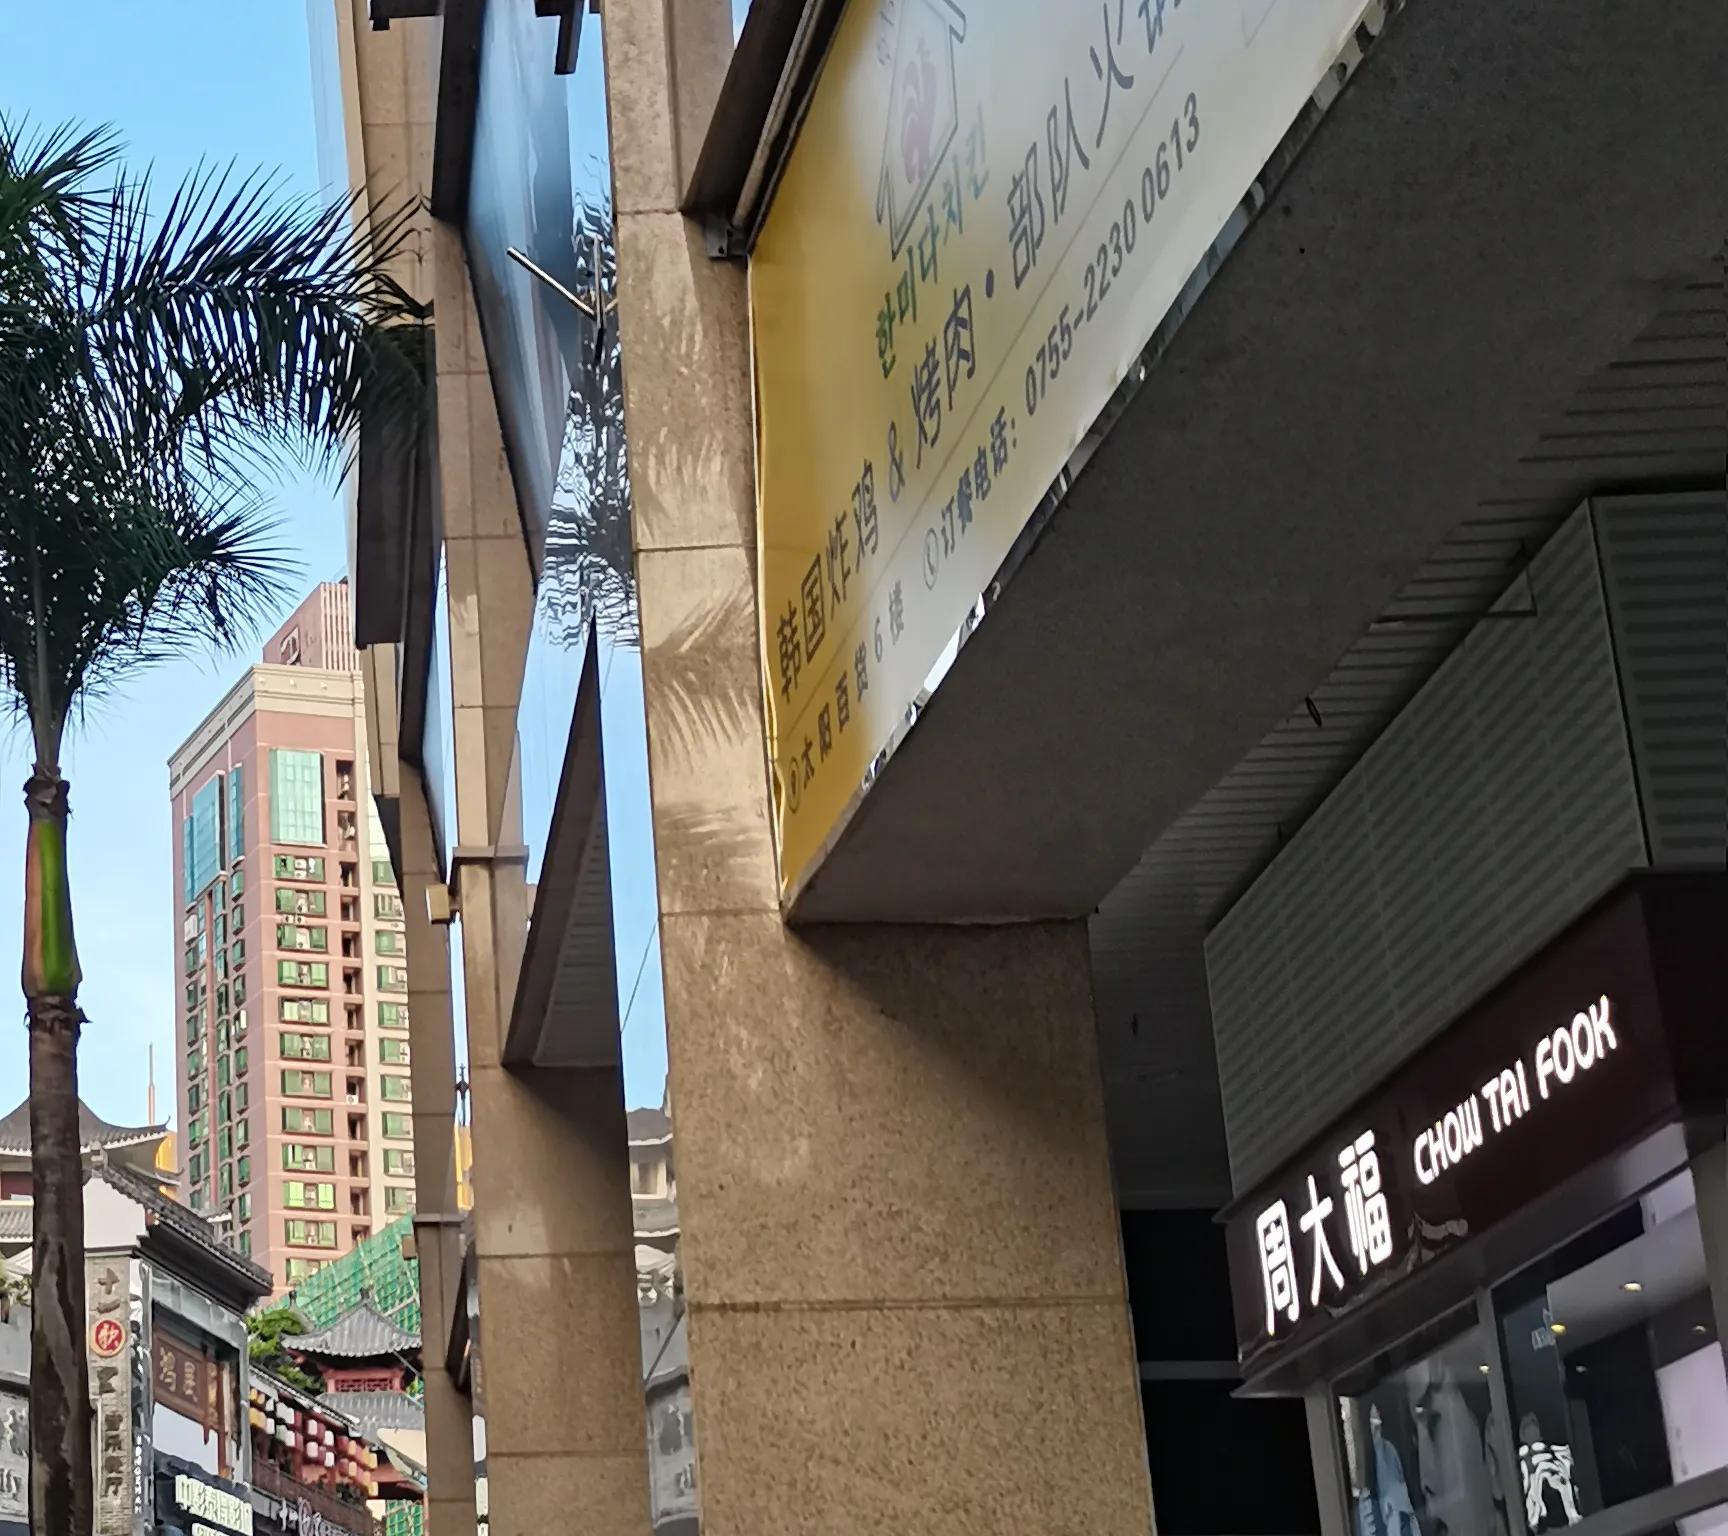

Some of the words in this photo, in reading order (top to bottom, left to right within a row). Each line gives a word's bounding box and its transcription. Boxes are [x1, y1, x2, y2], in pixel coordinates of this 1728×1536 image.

[876, 100, 989, 379] 한미다치킨
[1025, 198, 1137, 417] 0755-2230
[777, 458, 879, 703] 韩国炸鸡
[1414, 1094, 1484, 1186] CHOW
[1483, 1061, 1530, 1135] TAI
[1536, 995, 1618, 1100] FOOK
[1257, 1128, 1394, 1336] 周大福
